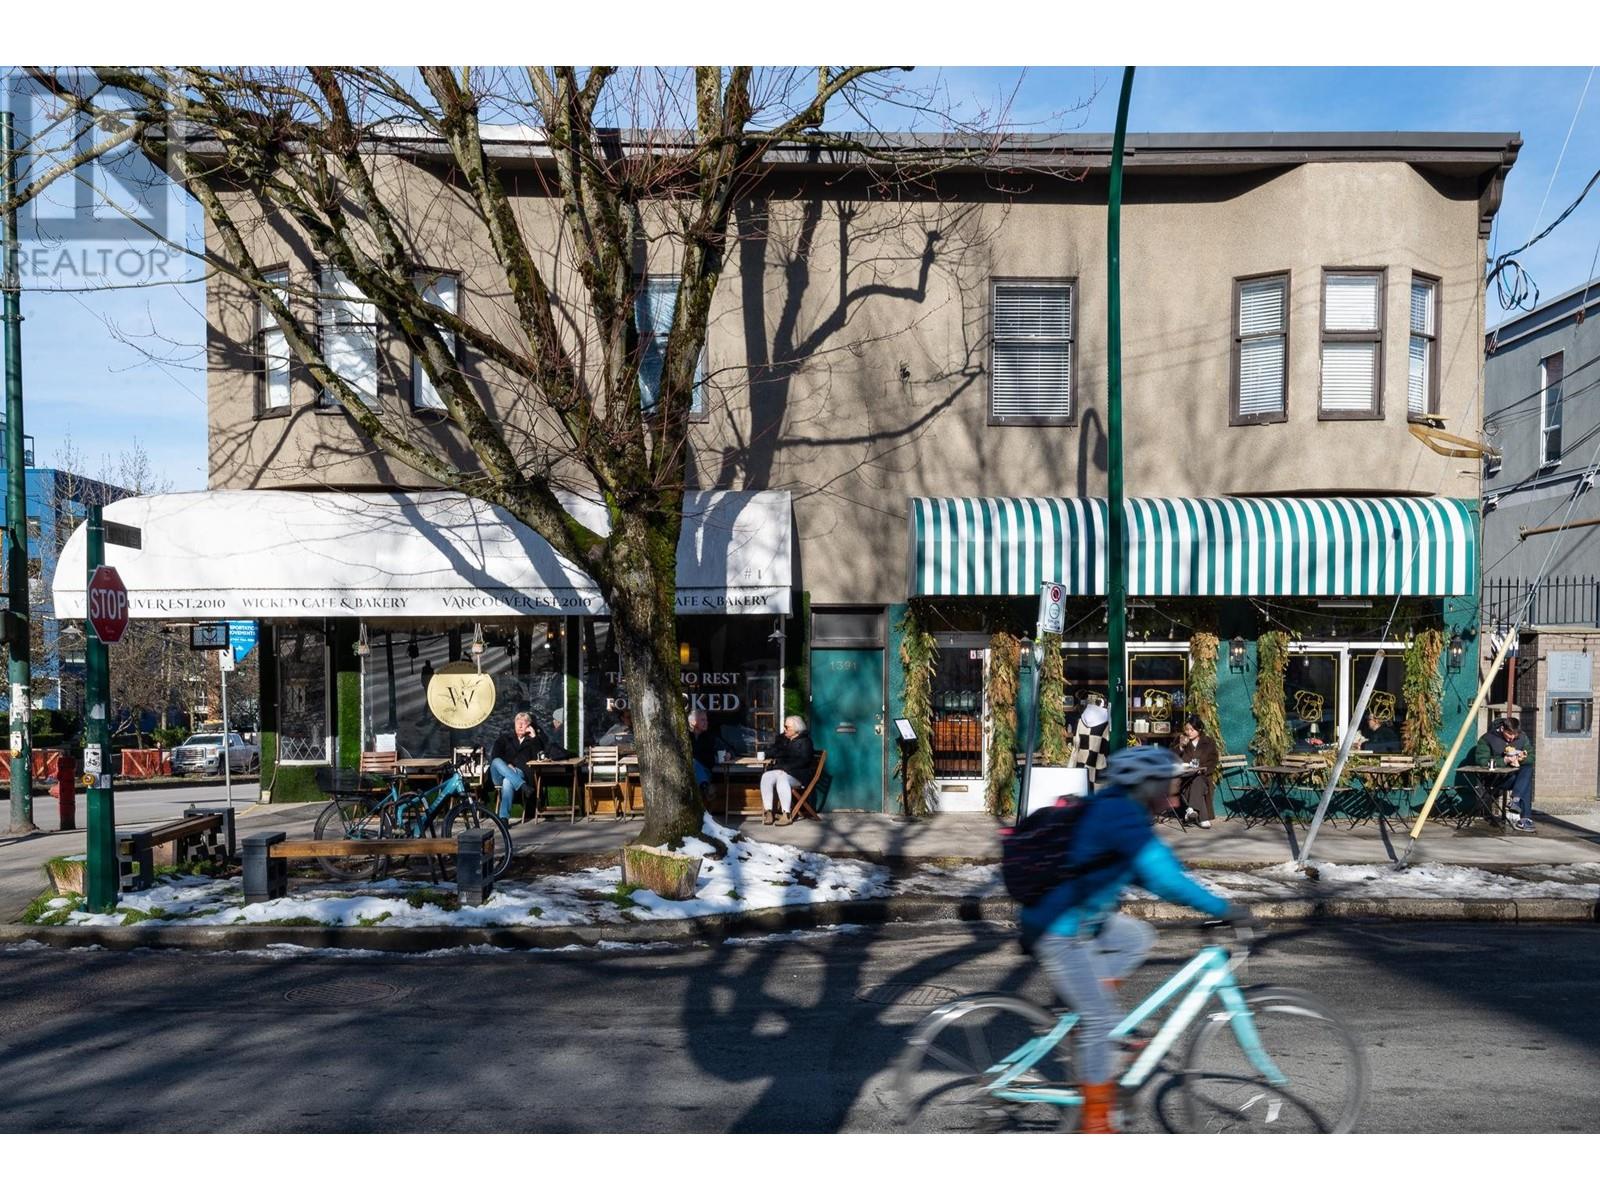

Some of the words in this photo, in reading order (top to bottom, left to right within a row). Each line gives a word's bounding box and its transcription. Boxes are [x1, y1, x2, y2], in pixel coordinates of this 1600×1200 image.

[91, 588, 126, 620] STOP
[242, 598, 299, 609] WICKED
[339, 598, 355, 610] &
[355, 597, 409, 609] BAKERY
[442, 596, 534, 611] VANCOUVER
[675, 595, 698, 606] AFE
[702, 595, 716, 608] &
[717, 595, 769, 607] BAKERY
[702, 672, 740, 684] REST
[606, 697, 631, 711] FO
[682, 692, 740, 711] KED
